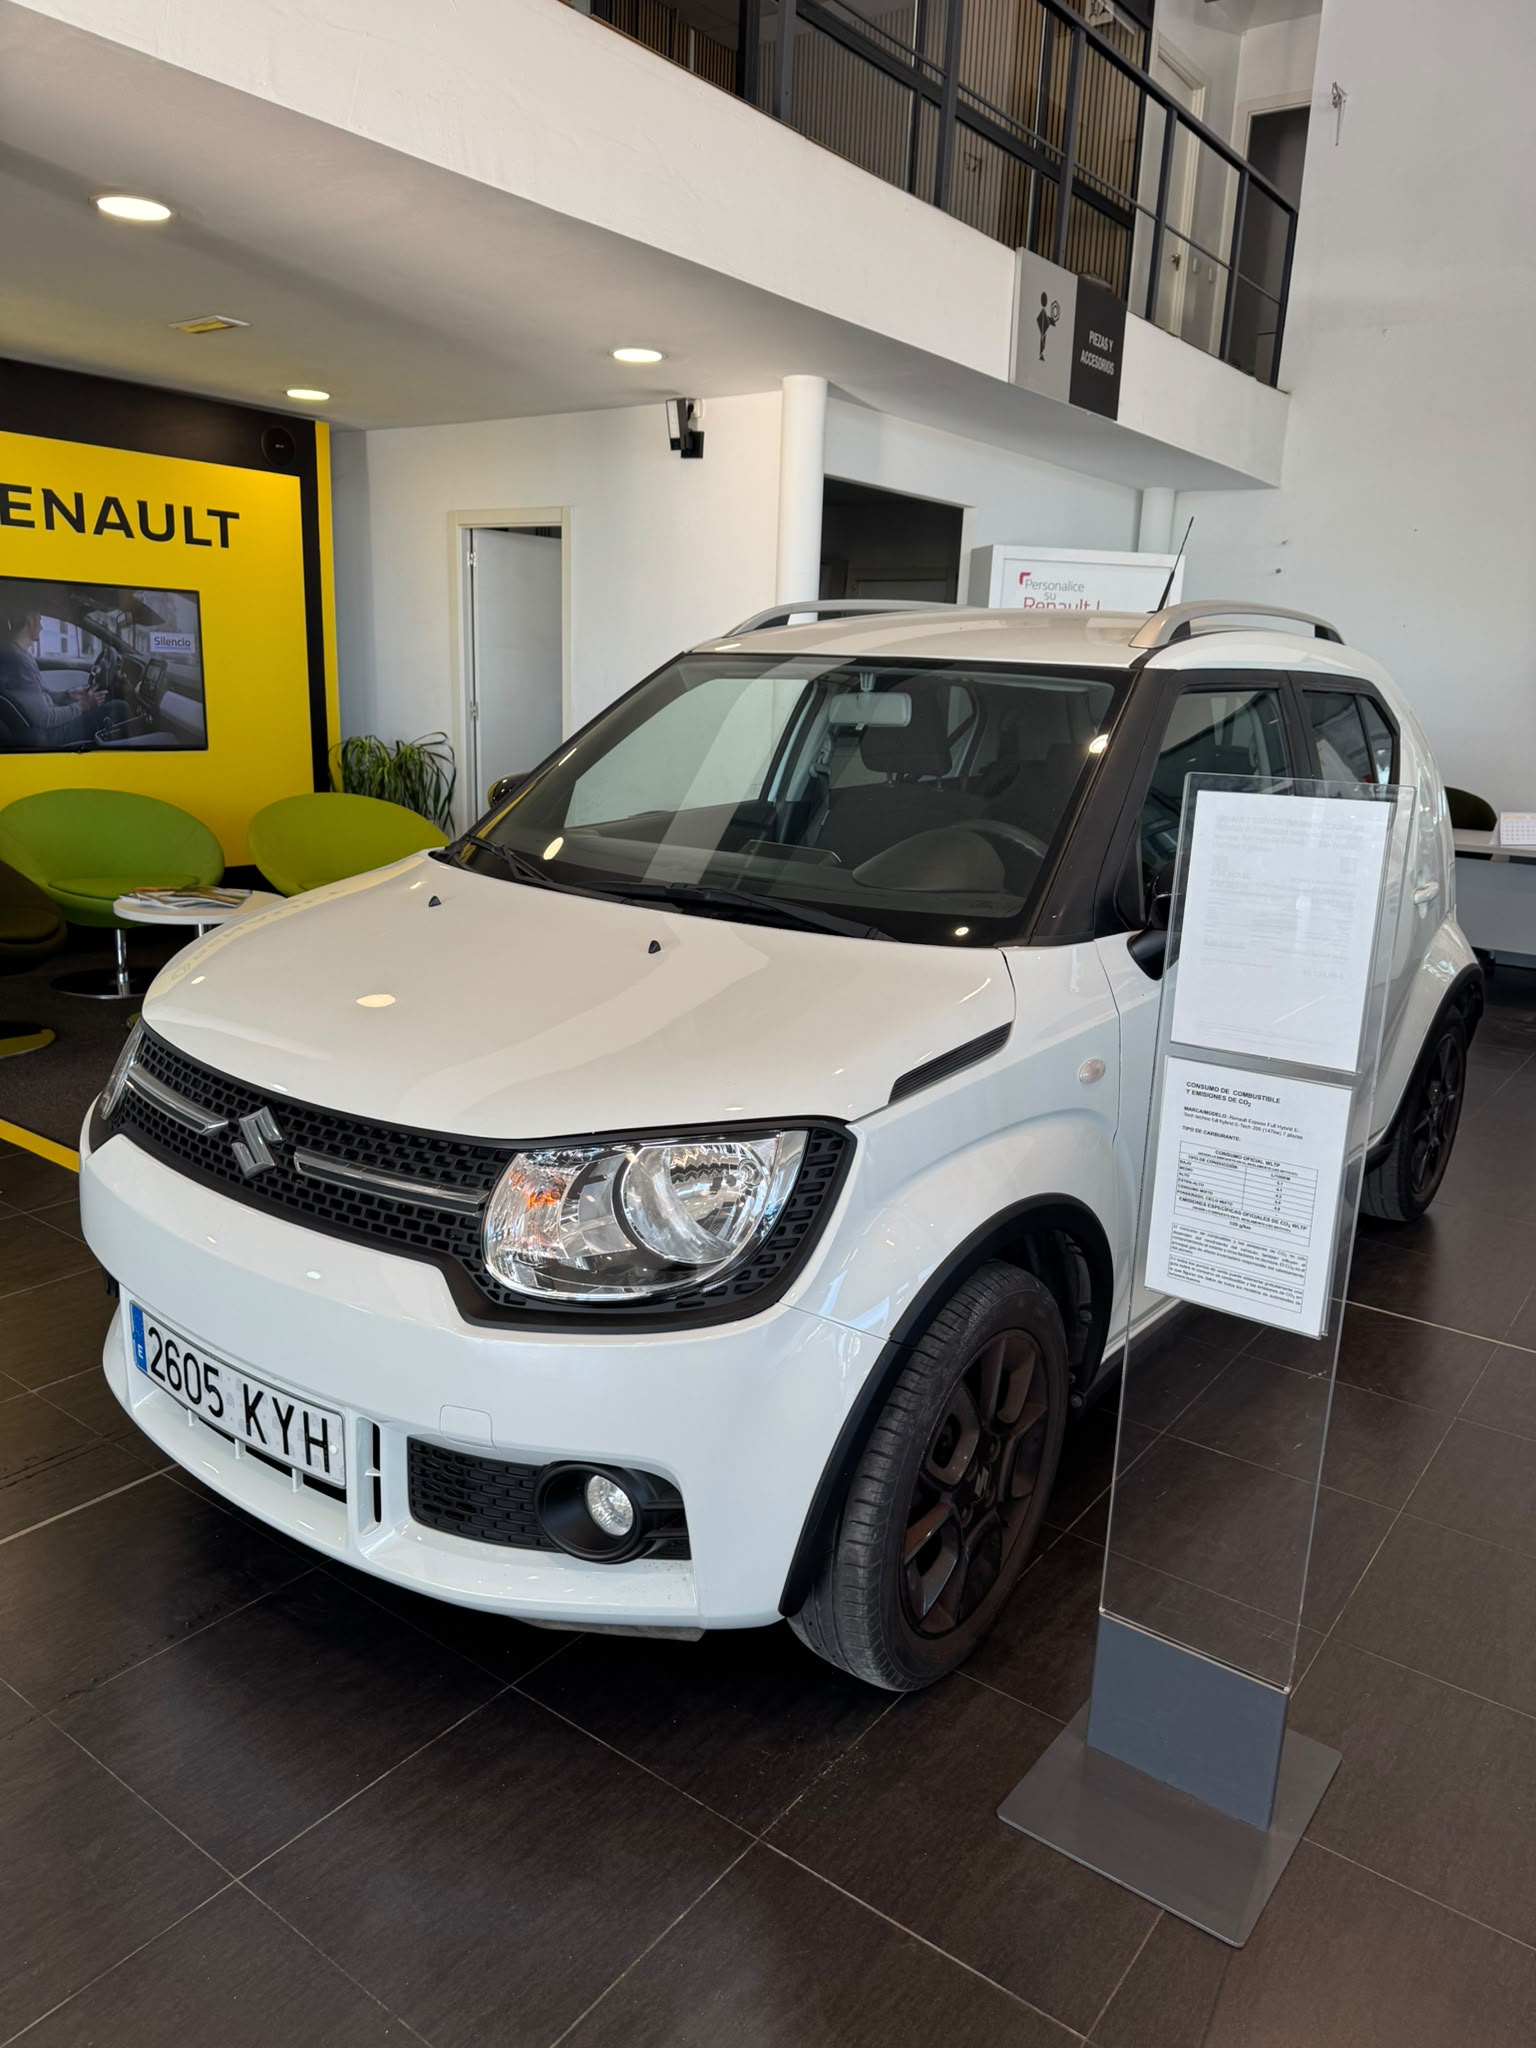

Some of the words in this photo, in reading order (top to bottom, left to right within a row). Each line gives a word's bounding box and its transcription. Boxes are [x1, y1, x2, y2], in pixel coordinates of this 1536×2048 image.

[1089, 330, 1108, 352] PIEZAS
[1109, 339, 1114, 352] Y
[1080, 349, 1114, 376] ACCESORIOS
[1024, 579, 1084, 592] Personalice
[1044, 592, 1056, 601] su
[154, 636, 191, 648] Silencio
[1187, 1081, 1219, 1092] CONSUMO
[1233, 1090, 1280, 1104] COMBUSTIBLE
[1192, 1090, 1227, 1101] EMISIONES
[137, 1344, 144, 1359] E
[148, 1327, 224, 1418] 2605
[243, 1383, 330, 1474] KYH
